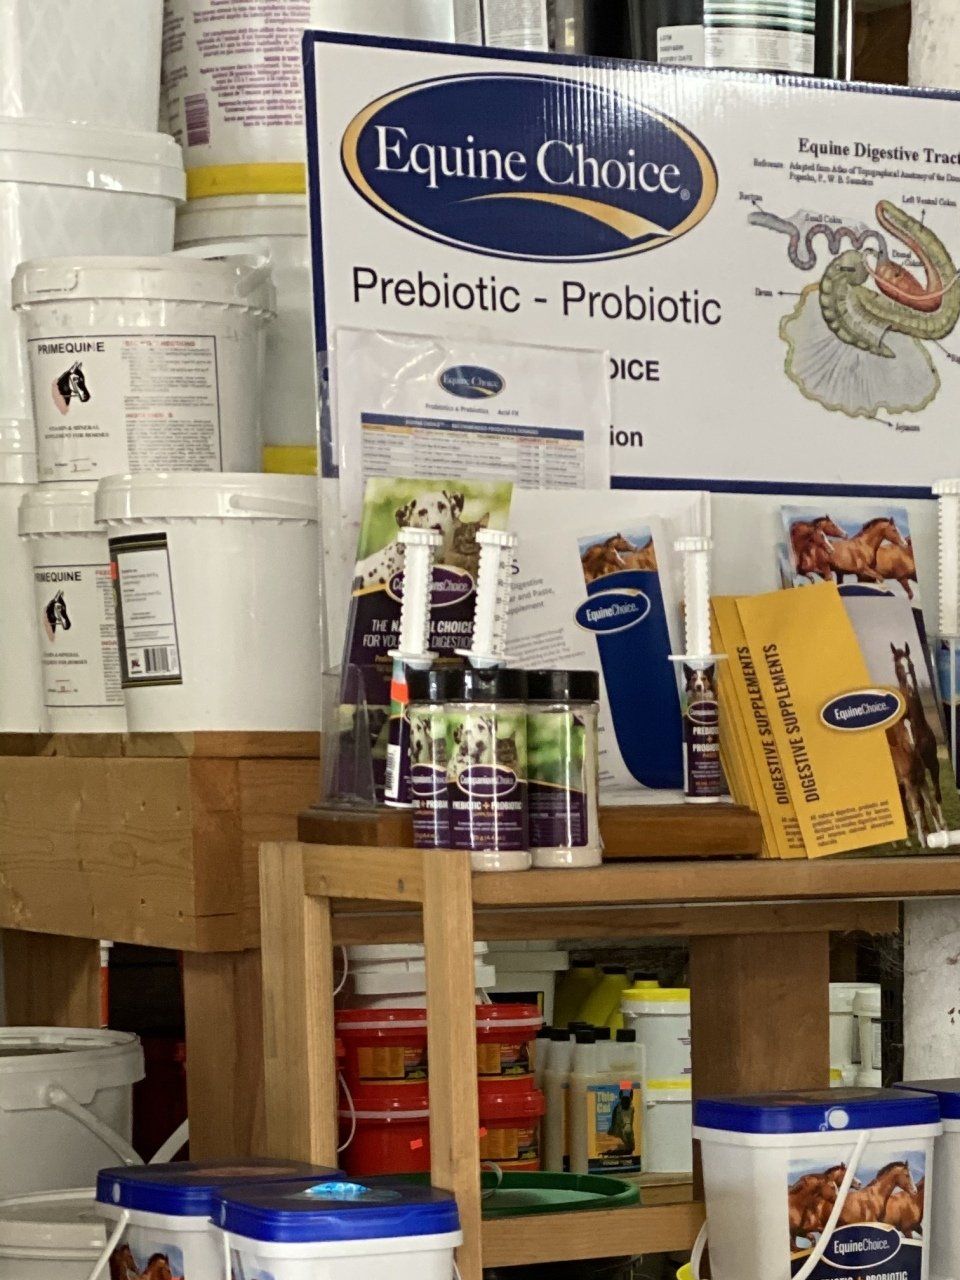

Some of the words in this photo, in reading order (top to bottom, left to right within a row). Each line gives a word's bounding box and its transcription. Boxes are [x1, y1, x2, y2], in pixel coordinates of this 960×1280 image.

[374, 124, 528, 190] Equine
[798, 137, 850, 159] Equine
[853, 142, 919, 163] Digestive
[352, 266, 520, 313] Prebiotic
[562, 281, 722, 326] Probiotic
[362, 634, 380, 648] FOR
[371, 618, 388, 632] THE
[736, 646, 772, 737] SUPPLEMENTS
[762, 643, 801, 735] SUPPLEMENTS
[762, 738, 790, 805] DIGESTIVE
[789, 736, 820, 803] DIGESTIVE
